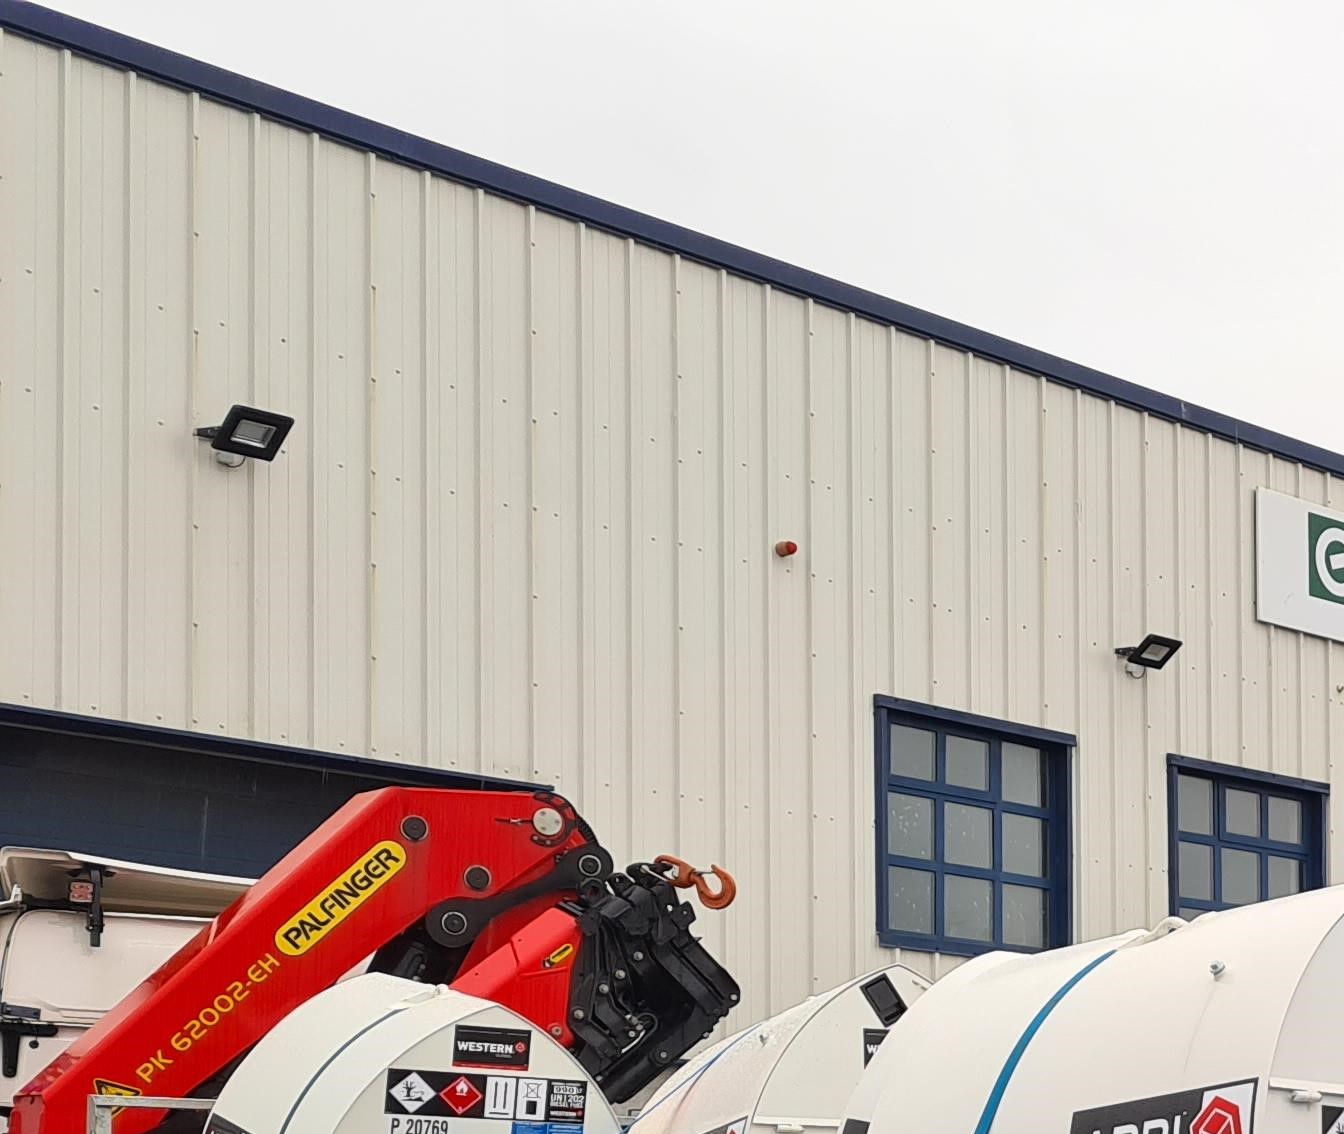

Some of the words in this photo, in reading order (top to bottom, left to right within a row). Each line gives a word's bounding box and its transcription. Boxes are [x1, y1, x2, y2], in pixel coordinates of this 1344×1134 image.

[282, 847, 400, 950] PALFINGER
[135, 1049, 174, 1083] PK
[170, 952, 281, 1052] 62002-EH
[457, 1041, 514, 1054] WESTERN
[391, 1118, 400, 1134] P
